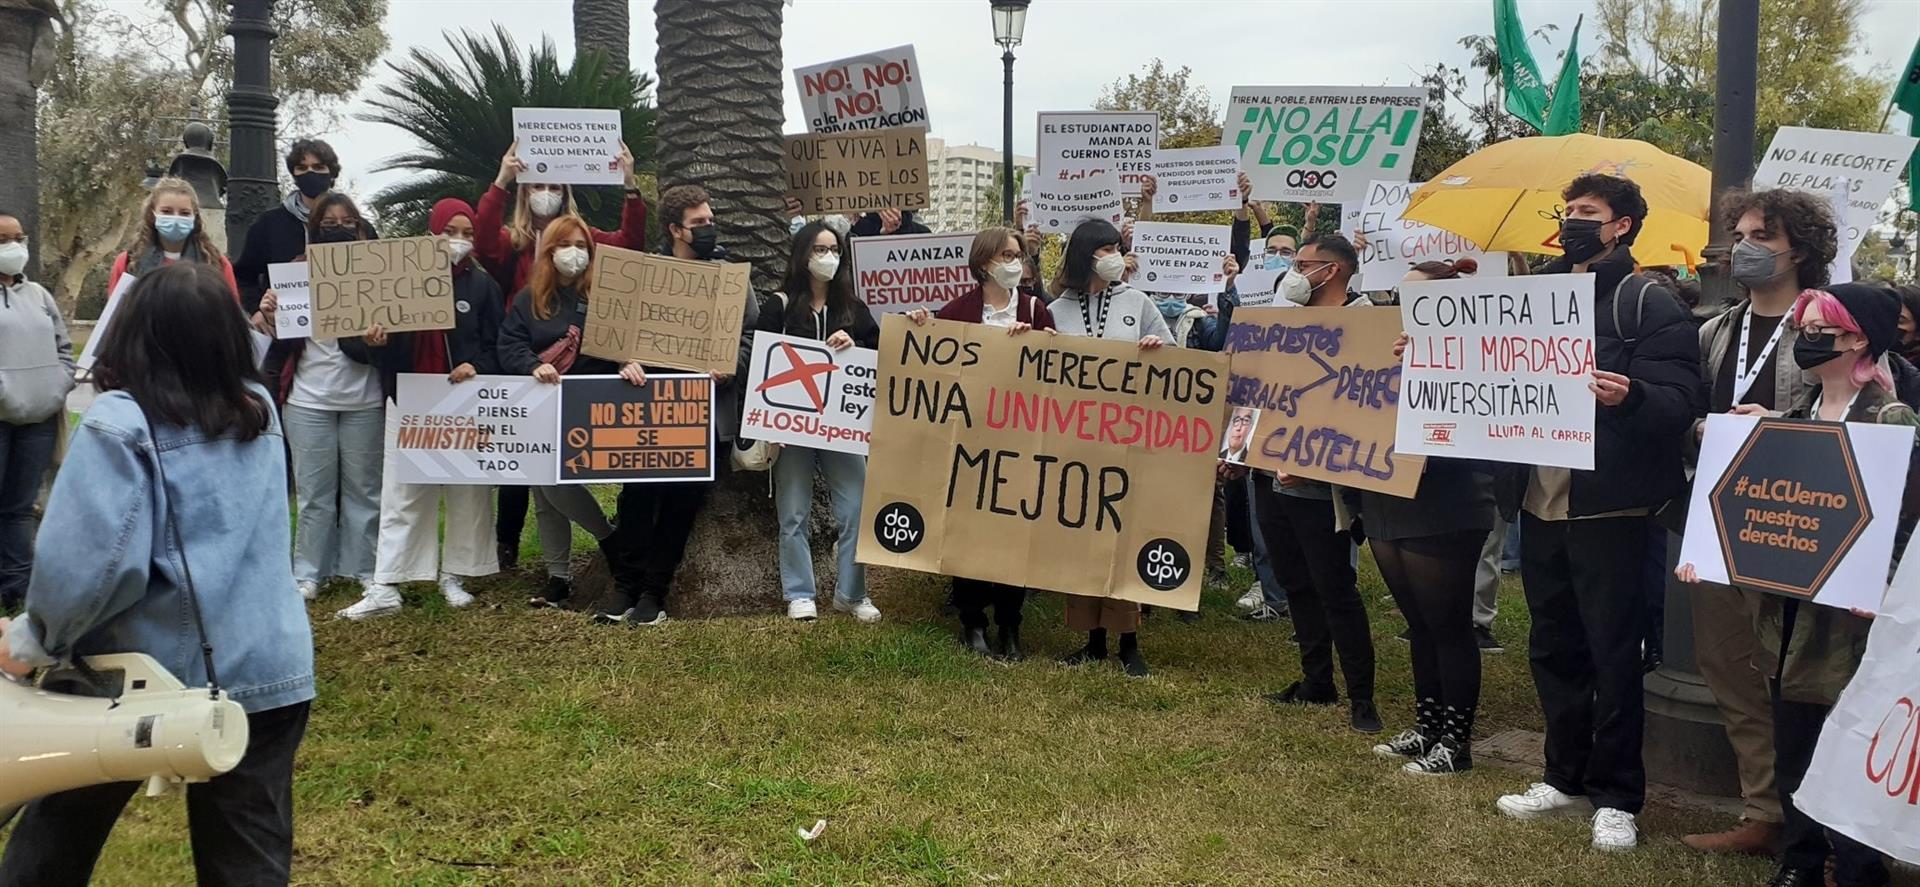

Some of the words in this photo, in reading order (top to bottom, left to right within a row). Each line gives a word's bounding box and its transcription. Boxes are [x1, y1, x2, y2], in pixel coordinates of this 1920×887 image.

[803, 66, 852, 97] NO!
[862, 59, 912, 90] NO!
[834, 89, 883, 119] NO!
[1233, 95, 1259, 104] TIREN
[1260, 95, 1272, 104] AL
[1274, 95, 1307, 105] POBLE,
[1309, 95, 1348, 104] ENTREN
[1350, 96, 1367, 105] LES
[1369, 96, 1421, 107] EMPRESES
[518, 121, 582, 131] MERECEMOS
[586, 122, 617, 131] TENER
[813, 117, 822, 127] a
[823, 112, 838, 125] la
[1044, 124, 1057, 133] EL
[1061, 123, 1152, 133] ESTUDIANTADO
[1313, 106, 1339, 134] A
[1347, 106, 1392, 135] LA
[531, 135, 580, 143] DERECHO
[583, 135, 591, 143] A
[593, 135, 606, 144] LA
[791, 139, 828, 161] QUE
[896, 137, 921, 157] LA
[1088, 136, 1134, 146] MANDA
[1137, 136, 1152, 146] AL
[530, 147, 564, 156] SALUD
[567, 148, 608, 156] MENTAL
[1061, 149, 1110, 159] CUERNO
[1113, 149, 1152, 159] ESTAS
[1770, 148, 1796, 161] NO
[1799, 150, 1818, 164] AL
[1820, 153, 1897, 173] RECORTE
[1116, 162, 1151, 171] LEYES
[1155, 160, 1194, 169] NUESTROS
[1157, 170, 1195, 178] VENDIDOS
[790, 170, 847, 189] LUCHA
[857, 170, 881, 187] DE
[890, 168, 920, 184] LOS
[1167, 178, 1226, 187] PRESUPUESTOS
[1040, 191, 1055, 200] NO
[1057, 193, 1071, 201] LO
[1035, 202, 1048, 211] YO
[1362, 212, 1392, 234] EL
[1142, 234, 1154, 242] Sr.
[1156, 235, 1206, 245] CASTELLS,
[1208, 237, 1220, 245] EL
[308, 238, 450, 278] NUESTROS
[886, 246, 964, 263] AVANZAR
[1134, 246, 1209, 257] ESTUDIANTADO
[1362, 238, 1395, 264] DEL
[1149, 259, 1170, 267] VIVE
[1174, 260, 1187, 268] EN
[1189, 261, 1209, 269] PAZ
[597, 255, 721, 300] ESTUDIAR
[723, 271, 745, 296] ES
[316, 274, 451, 311] DERECHOS
[866, 283, 977, 305] ESTUDIANT
[595, 296, 632, 321] UN
[715, 305, 740, 334] NO
[1412, 293, 1533, 327] CONTRA
[1551, 290, 1580, 325] LA
[594, 325, 626, 351] UN
[635, 328, 737, 362] PRIVILEGIO
[1410, 336, 1464, 370] LLEI
[1481, 335, 1596, 376] MORDASSA
[901, 330, 982, 366] NOS
[1018, 345, 1217, 405] MERECEMOS
[477, 388, 509, 400] QUE
[653, 380, 675, 401] LA
[680, 379, 709, 400] UNI
[477, 406, 528, 418] PIENSE
[590, 402, 616, 425] NO
[621, 402, 645, 425] SE
[650, 402, 709, 425] VENDE
[840, 395, 869, 420] ley
[888, 376, 973, 428] UNA
[986, 386, 1214, 453] UNIVERSIDAD
[401, 415, 419, 426] SE
[424, 415, 476, 426] BUSCA
[477, 424, 496, 435] EN
[501, 424, 517, 435] EL
[636, 430, 659, 446] SE
[1488, 424, 1525, 438] LLUITA
[1532, 427, 1544, 438] AL
[1551, 429, 1592, 443] CARRER
[477, 442, 557, 454] ESTUDIAN-
[1261, 425, 1395, 481] CASTELLS
[477, 459, 519, 471] TADO
[608, 451, 695, 469] DEFIENDE
[946, 443, 1129, 533] MEJOR
[1734, 475, 1848, 510] #aLCUerno
[885, 508, 910, 528] da
[1745, 508, 1821, 531] nuestros
[883, 526, 919, 546] upv
[1739, 521, 1819, 553] derechos
[1148, 544, 1175, 565] da
[1146, 562, 1184, 584] upv
